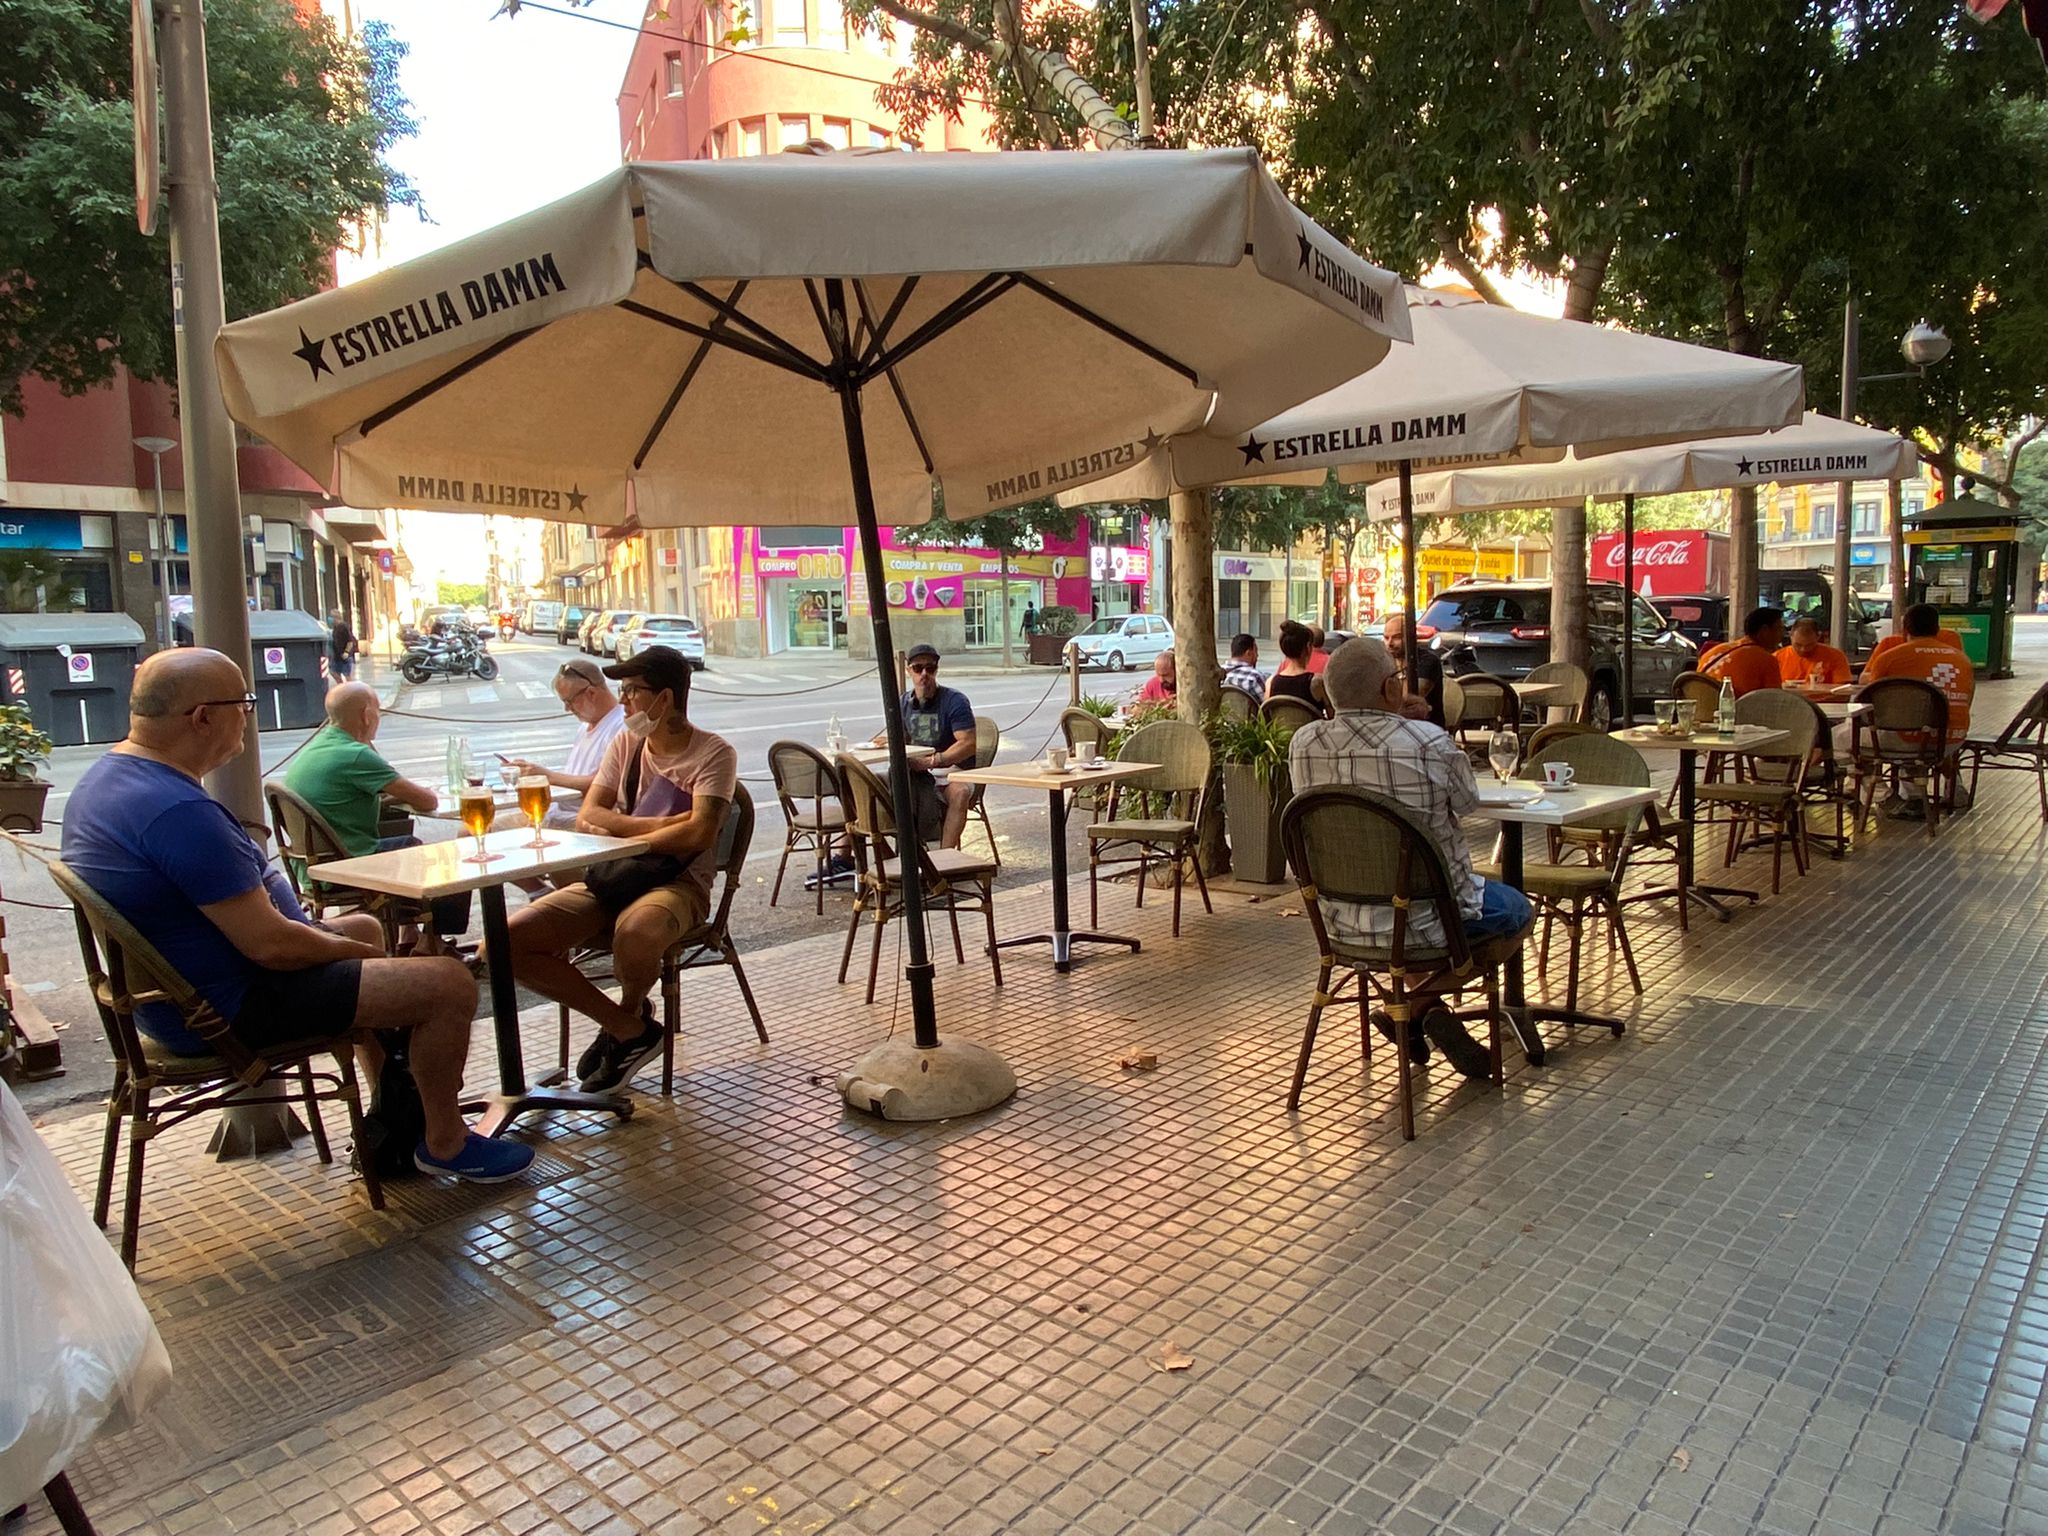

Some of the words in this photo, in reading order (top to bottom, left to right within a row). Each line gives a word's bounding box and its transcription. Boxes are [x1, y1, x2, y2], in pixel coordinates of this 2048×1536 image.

[1314, 246, 1359, 306] ESTRELLA
[1360, 280, 1385, 324] DAMM
[330, 290, 462, 368] ESTRELLA
[460, 252, 567, 321] DAMM
[1273, 424, 1383, 461] ESTRELLA
[1391, 413, 1467, 442] DAMM
[1757, 457, 1821, 475] ESTRELLA
[1826, 455, 1867, 470] DAMM
[1142, 524, 1151, 550] CAR
[760, 561, 797, 572] COMPRO
[797, 553, 846, 580] ORO
[890, 559, 927, 571] COMPRA
[929, 561, 935, 571] Y
[937, 561, 964, 572] VENTA
[980, 563, 1020, 574] EMPEOS
